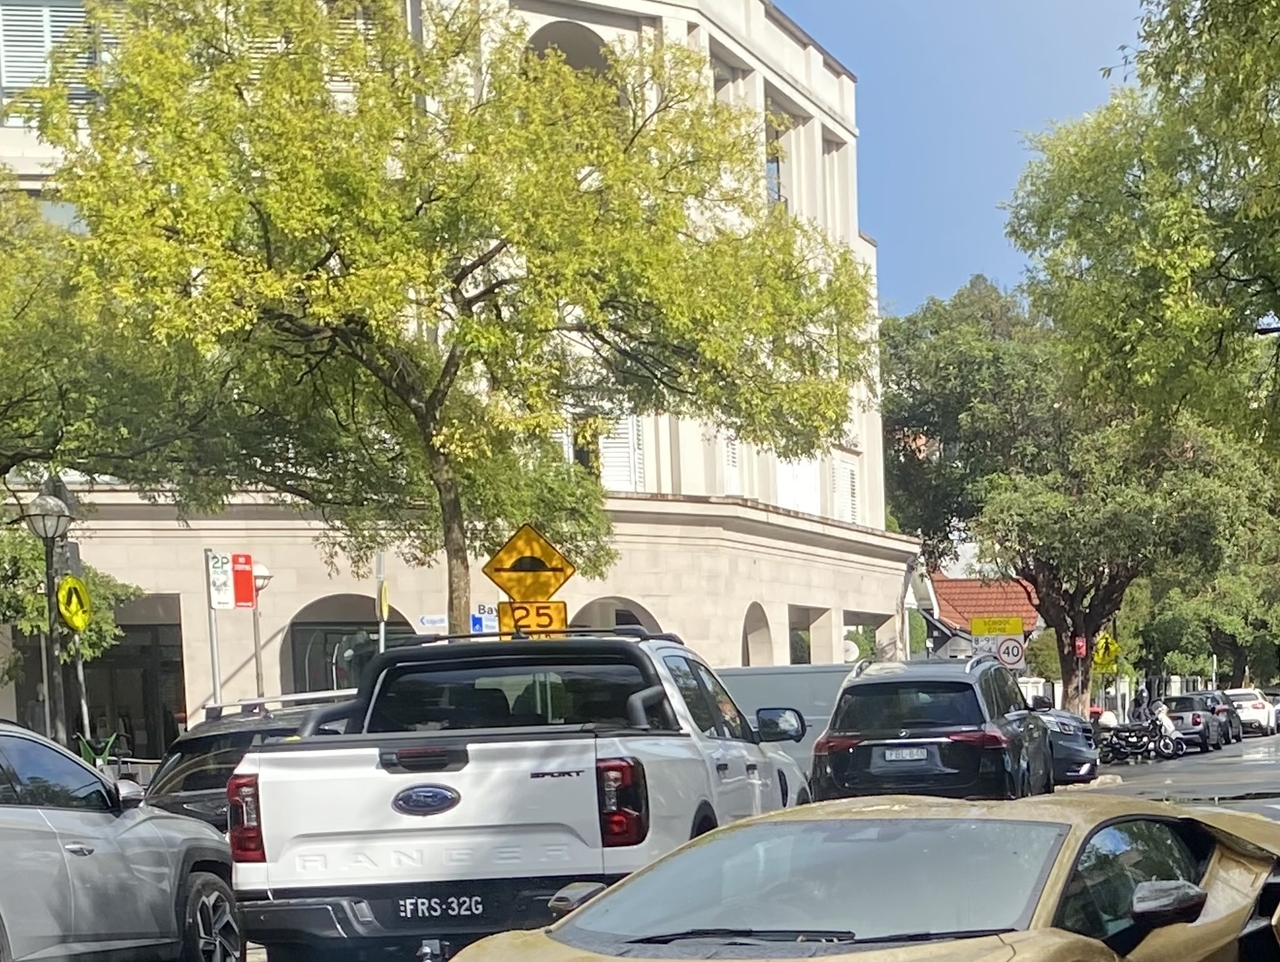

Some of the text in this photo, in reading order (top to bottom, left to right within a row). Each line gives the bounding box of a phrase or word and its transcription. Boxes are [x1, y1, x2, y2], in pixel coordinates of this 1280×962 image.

[211, 556, 230, 569] 2P
[513, 606, 553, 628] 25
[1002, 645, 1020, 657] 40
[530, 770, 585, 779] SPORT
[295, 844, 571, 873] RANGER
